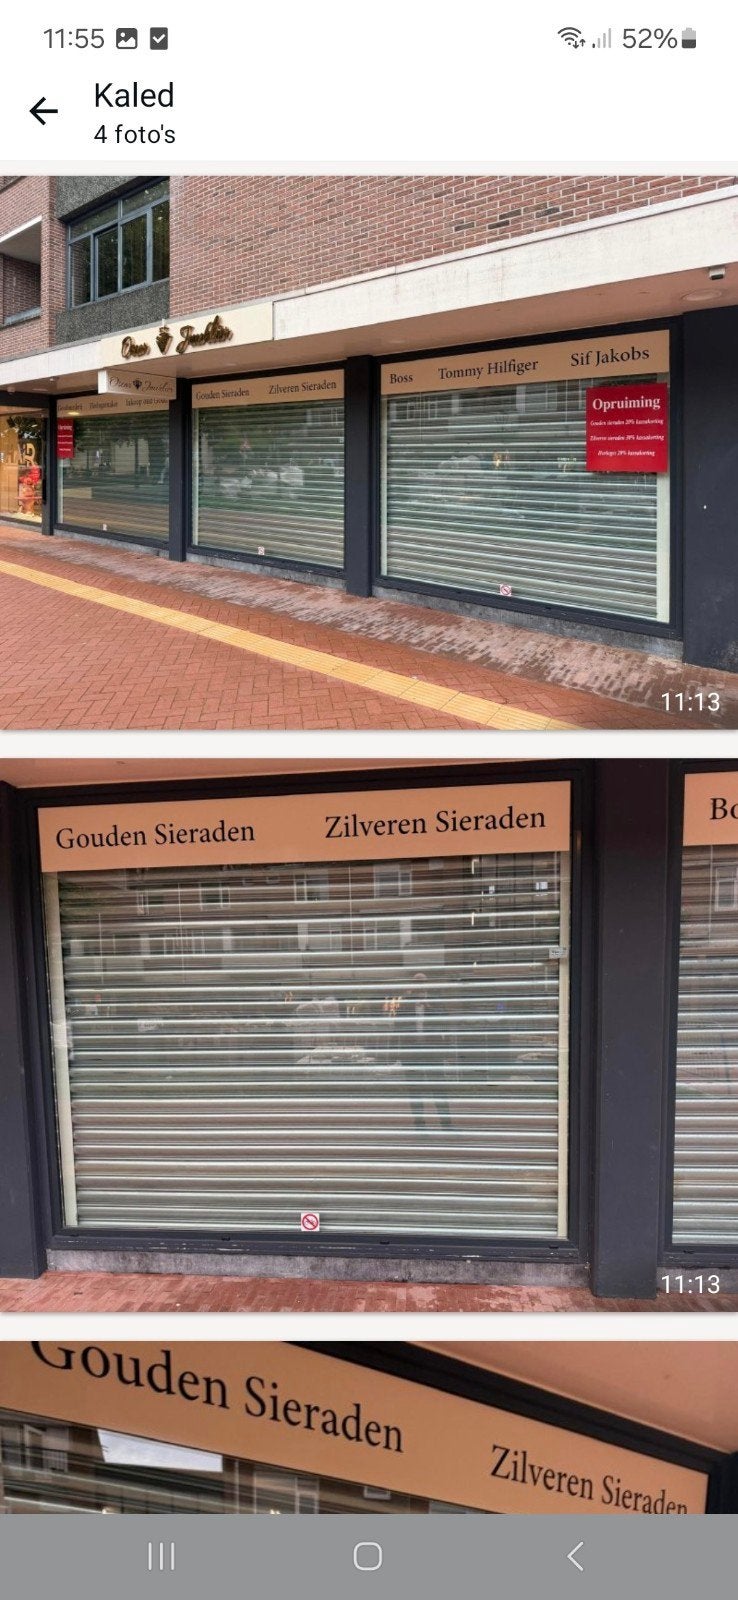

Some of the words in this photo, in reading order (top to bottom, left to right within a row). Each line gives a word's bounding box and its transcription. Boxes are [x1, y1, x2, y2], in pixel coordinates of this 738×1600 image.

[43, 28, 105, 49] 11:55
[622, 28, 678, 49] 52%
[94, 81, 175, 108] Kaled
[94, 124, 107, 144] 4
[114, 123, 176, 144] foto's
[570, 351, 593, 367] Sif
[595, 346, 650, 367] Jakobs
[389, 373, 414, 385] Boss
[437, 366, 484, 380] Tommy
[487, 359, 539, 376] Hilfiger
[196, 389, 221, 401] Gouden
[222, 387, 250, 399] Sieraden
[268, 384, 300, 395] Zilveren
[301, 380, 337, 392] Sieraden
[592, 395, 661, 413] Opruiming
[325, 813, 428, 839] Zilveren
[436, 805, 546, 833] Sieraden
[56, 825, 147, 850] Gouden
[154, 819, 255, 845] Sieraden
[30, 1341, 230, 1410] Gouden
[244, 1376, 404, 1453] Sieraden
[490, 1444, 594, 1501] Zilveren
[601, 1475, 688, 1514] Sieraden
